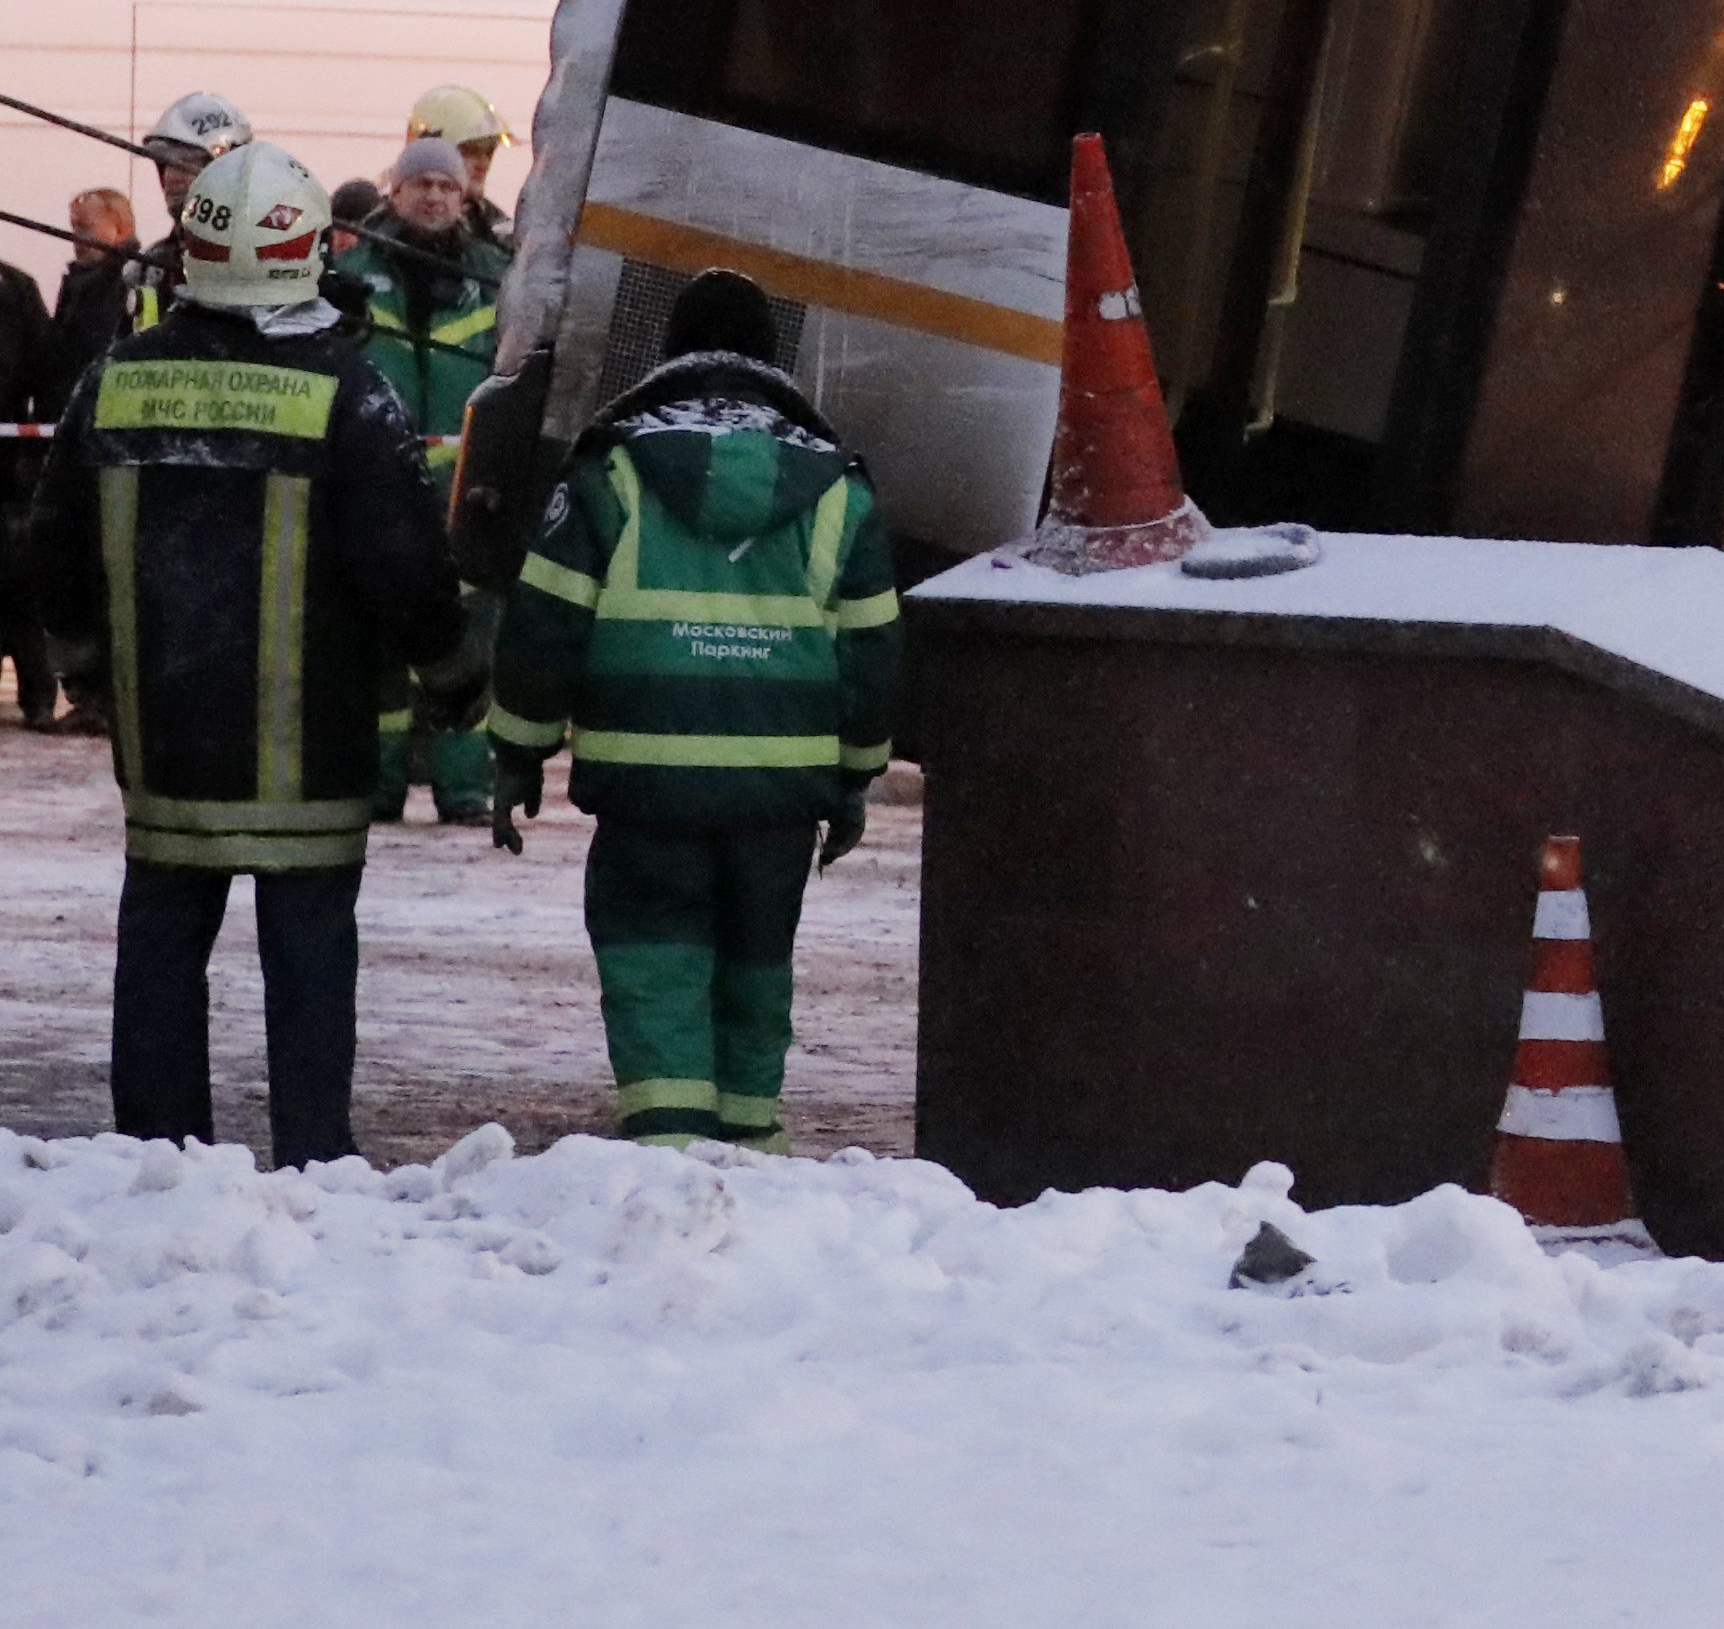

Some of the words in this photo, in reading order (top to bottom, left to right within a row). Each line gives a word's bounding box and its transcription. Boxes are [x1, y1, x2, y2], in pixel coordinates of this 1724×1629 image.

[115, 370, 224, 391] ПОЖАРНАЯ
[228, 371, 312, 399] ОХРАНА
[140, 398, 187, 422] МЧС
[193, 400, 276, 425] РОССИИ
[672, 622, 793, 642] Московский
[691, 640, 772, 660] Паркинг
